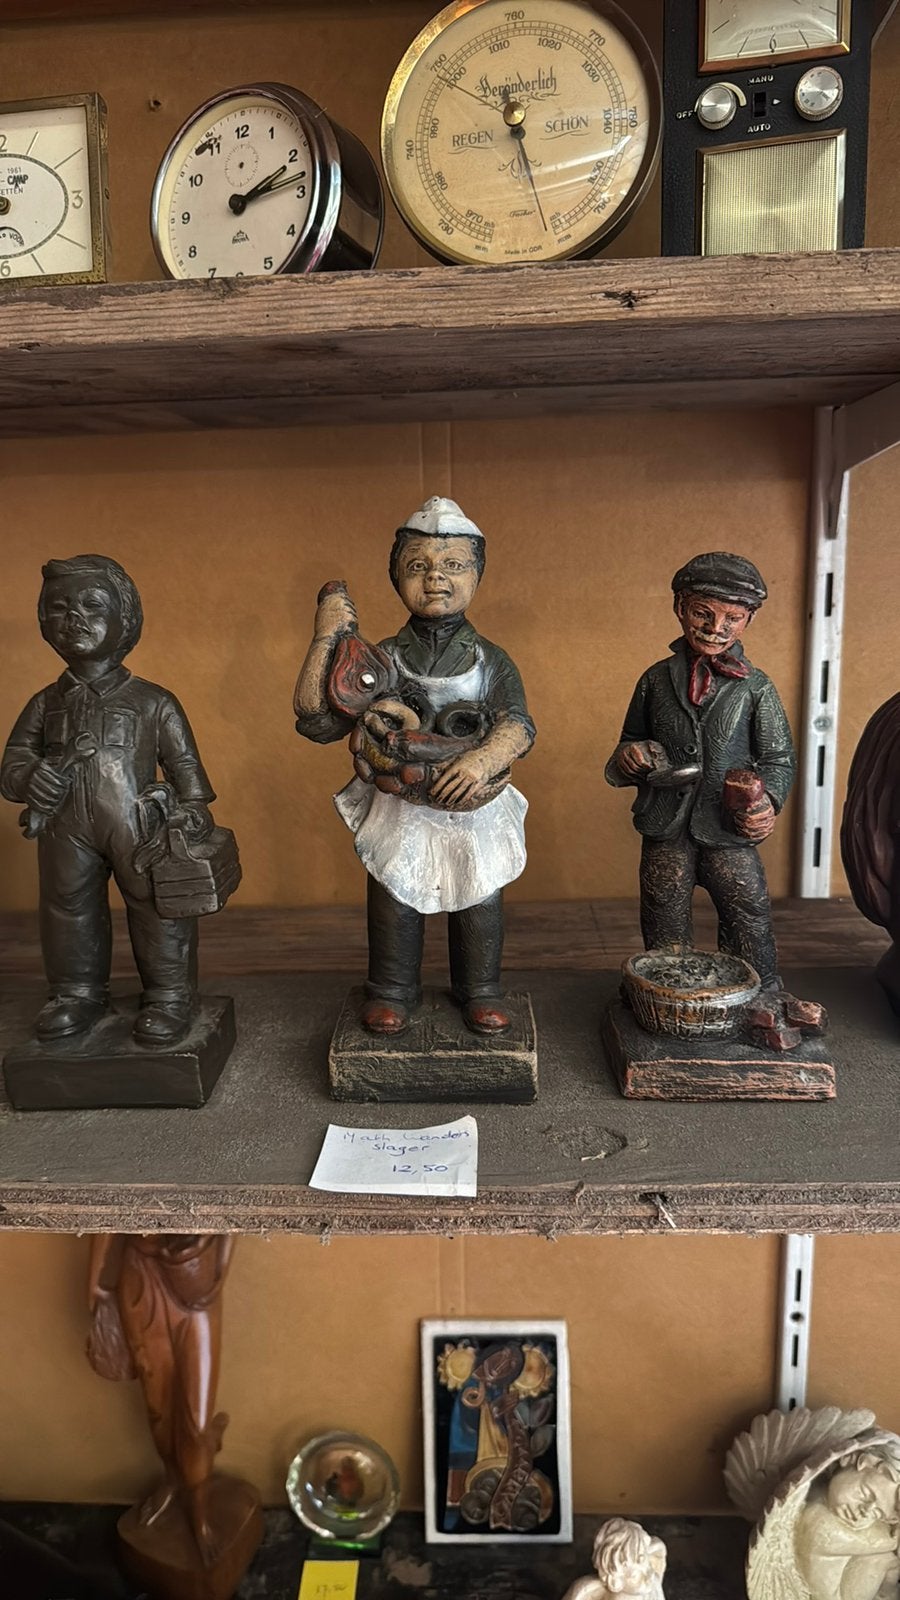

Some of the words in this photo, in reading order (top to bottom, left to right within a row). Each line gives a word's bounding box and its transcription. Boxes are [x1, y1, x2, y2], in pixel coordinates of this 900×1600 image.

[504, 10, 525, 21] 760
[537, 37, 562, 51] 1020
[588, 29, 606, 47] 770
[488, 39, 510, 54] 1010
[430, 53, 447, 73] 750
[446, 66, 467, 90] 1000
[581, 60, 601, 83] 1030
[748, 75, 774, 84] MANU
[603, 108, 612, 134] 1040
[629, 106, 638, 128] 780
[676, 111, 694, 119] OFF
[430, 118, 439, 139] 990
[544, 114, 589, 133] SCHÖN
[747, 123, 771, 133] AUTO
[235, 124, 250, 139] 12
[269, 126, 275, 139] 1
[452, 129, 494, 147] REGEN
[288, 149, 298, 163] 2
[405, 139, 415, 160] 740
[189, 174, 203, 187] 10
[434, 171, 449, 191] 980
[71, 190, 84, 209] 3
[296, 185, 306, 199] 3
[181, 212, 191, 225] 9
[465, 209, 483, 224] 970
[286, 224, 296, 237] 4
[438, 218, 454, 236] 730
[188, 245, 197, 258] 8
[0, 260, 11, 277] 6
[263, 256, 273, 270] 5
